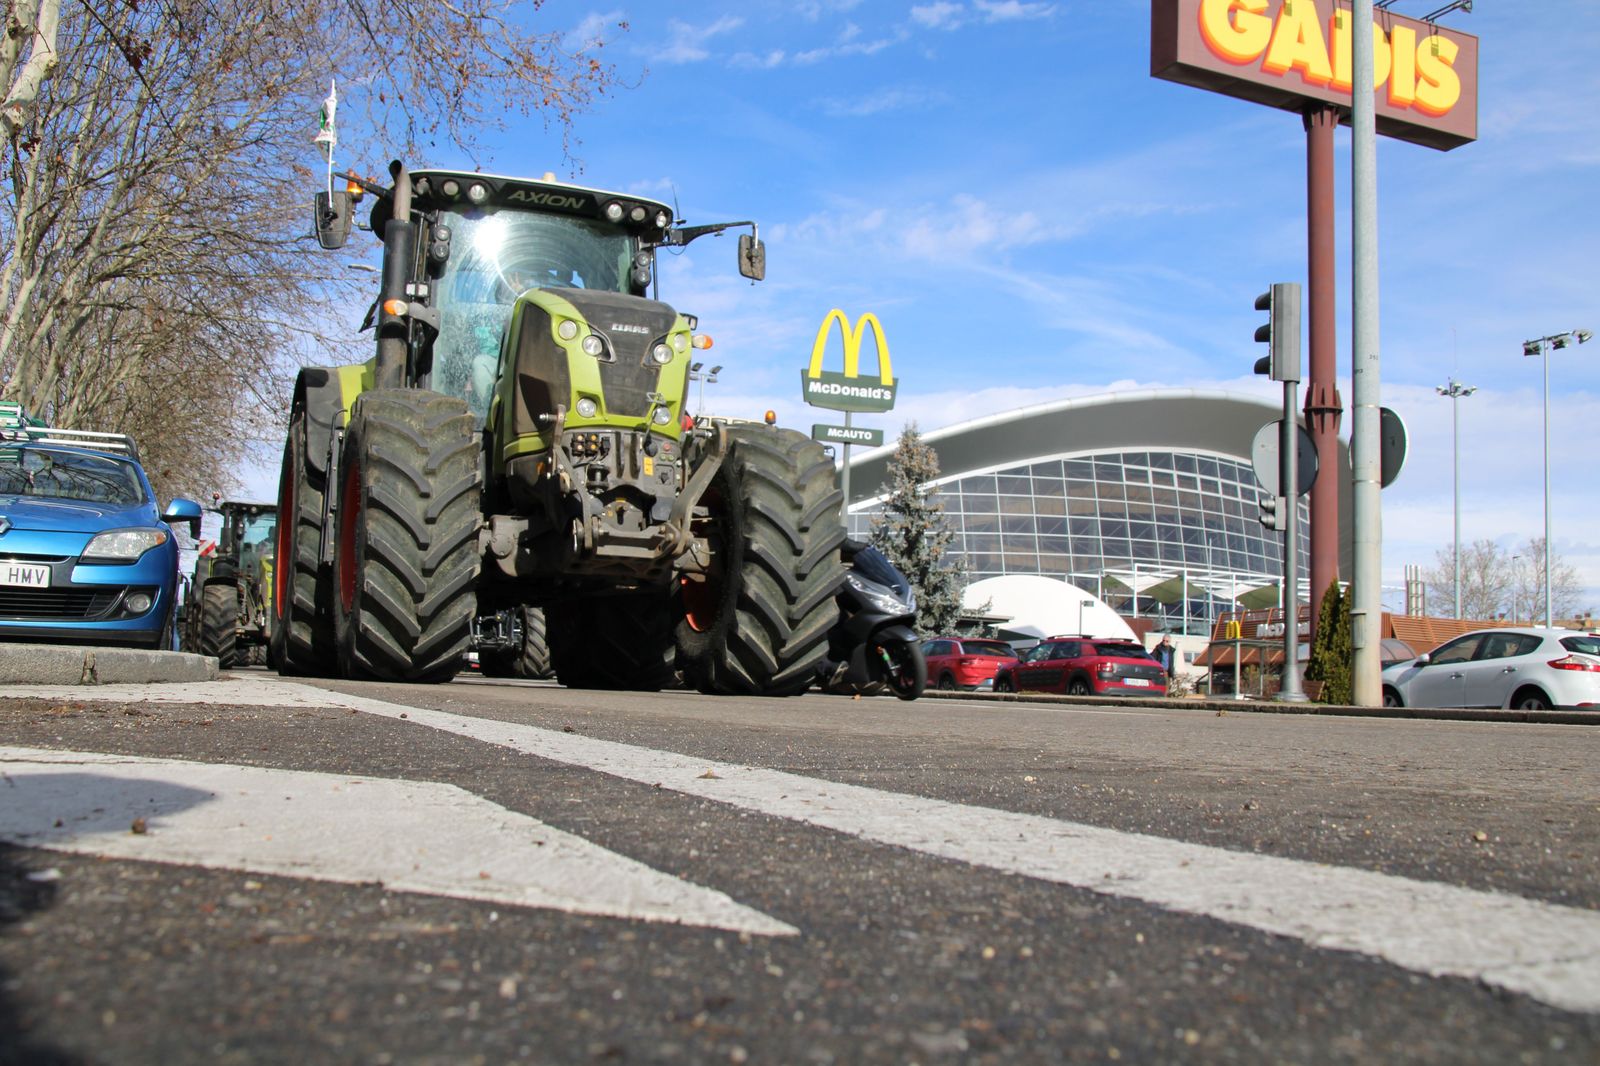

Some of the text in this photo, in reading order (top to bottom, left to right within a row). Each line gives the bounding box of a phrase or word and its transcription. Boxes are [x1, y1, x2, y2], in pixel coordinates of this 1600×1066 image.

[1197, 0, 1461, 118] GADIS
[507, 190, 585, 209] AXION
[808, 381, 892, 400] McDonald's
[827, 428, 872, 440] McAUTO
[8, 567, 45, 584] HMV
